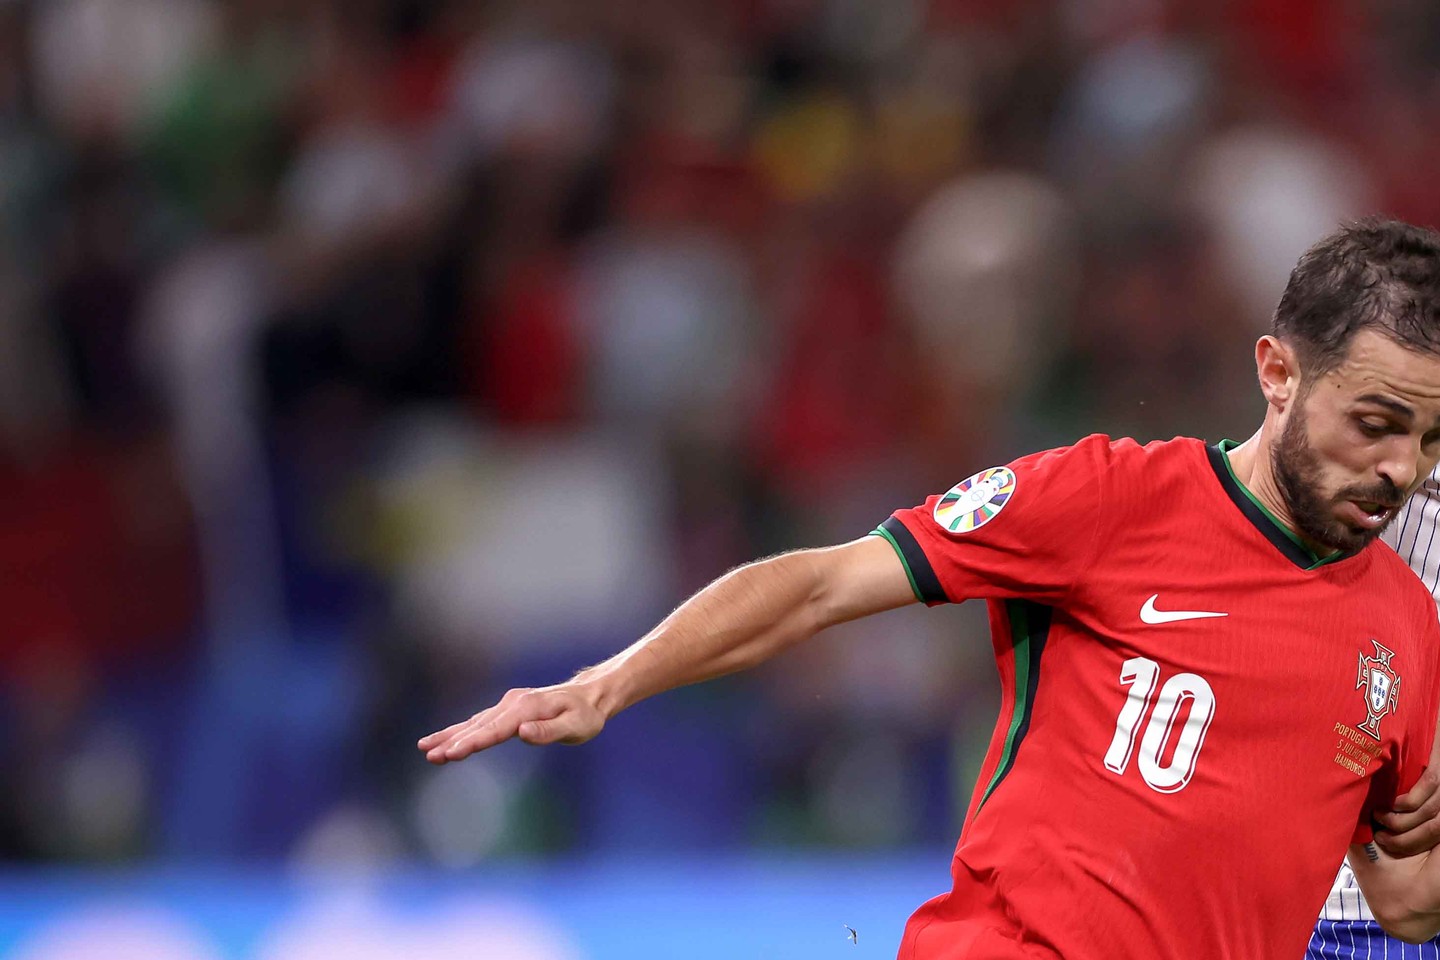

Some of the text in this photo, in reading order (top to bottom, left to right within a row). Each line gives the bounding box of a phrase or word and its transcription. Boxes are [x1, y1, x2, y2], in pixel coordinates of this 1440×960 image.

[1103, 656, 1216, 794] 10
[1336, 739, 1344, 749] 5
[1333, 752, 1366, 778] HAMBURGO
